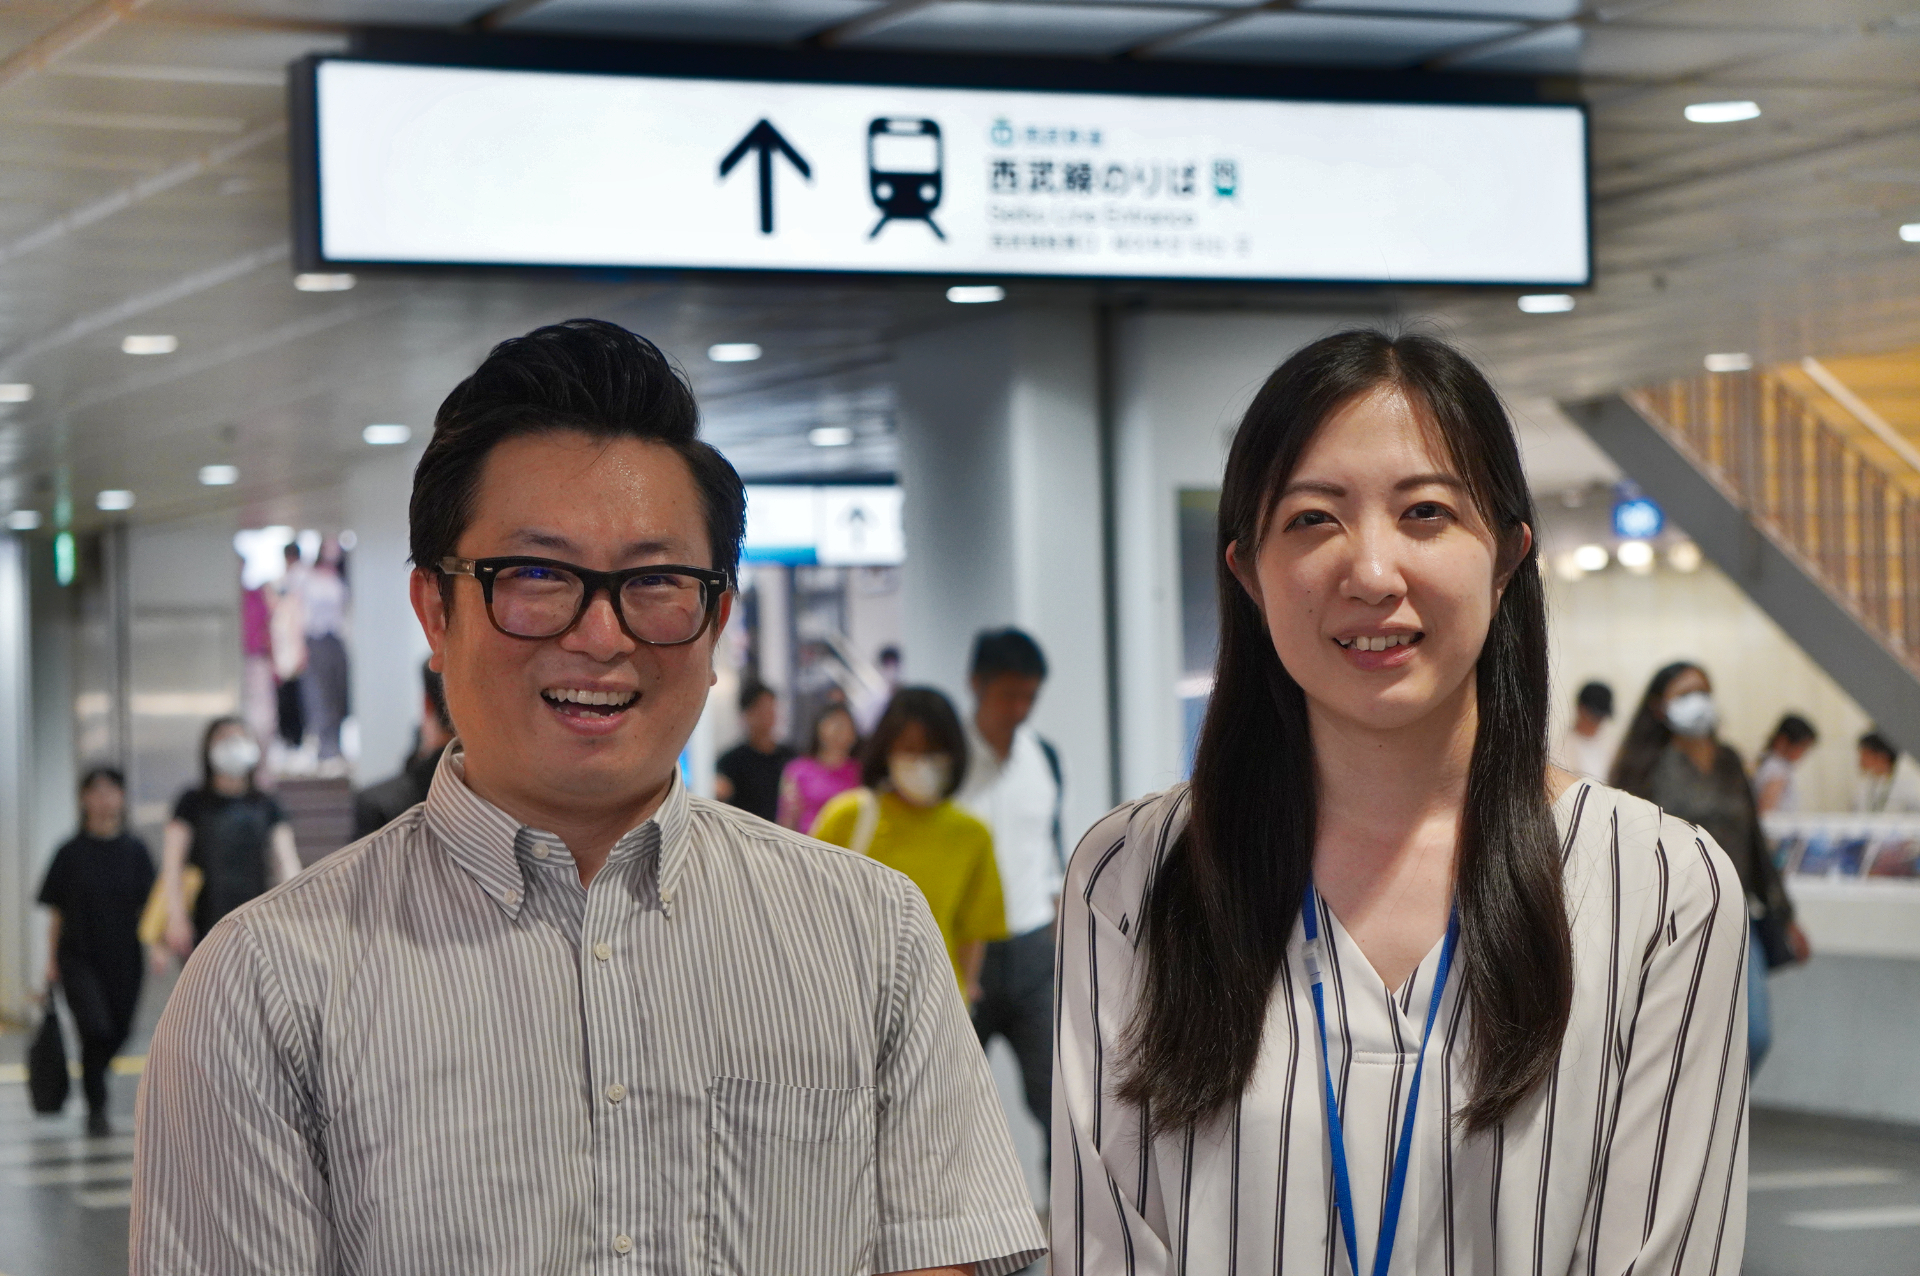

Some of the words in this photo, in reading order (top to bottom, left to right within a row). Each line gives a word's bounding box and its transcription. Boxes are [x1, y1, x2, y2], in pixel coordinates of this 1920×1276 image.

[990, 161, 1197, 197] 西武線のりば
